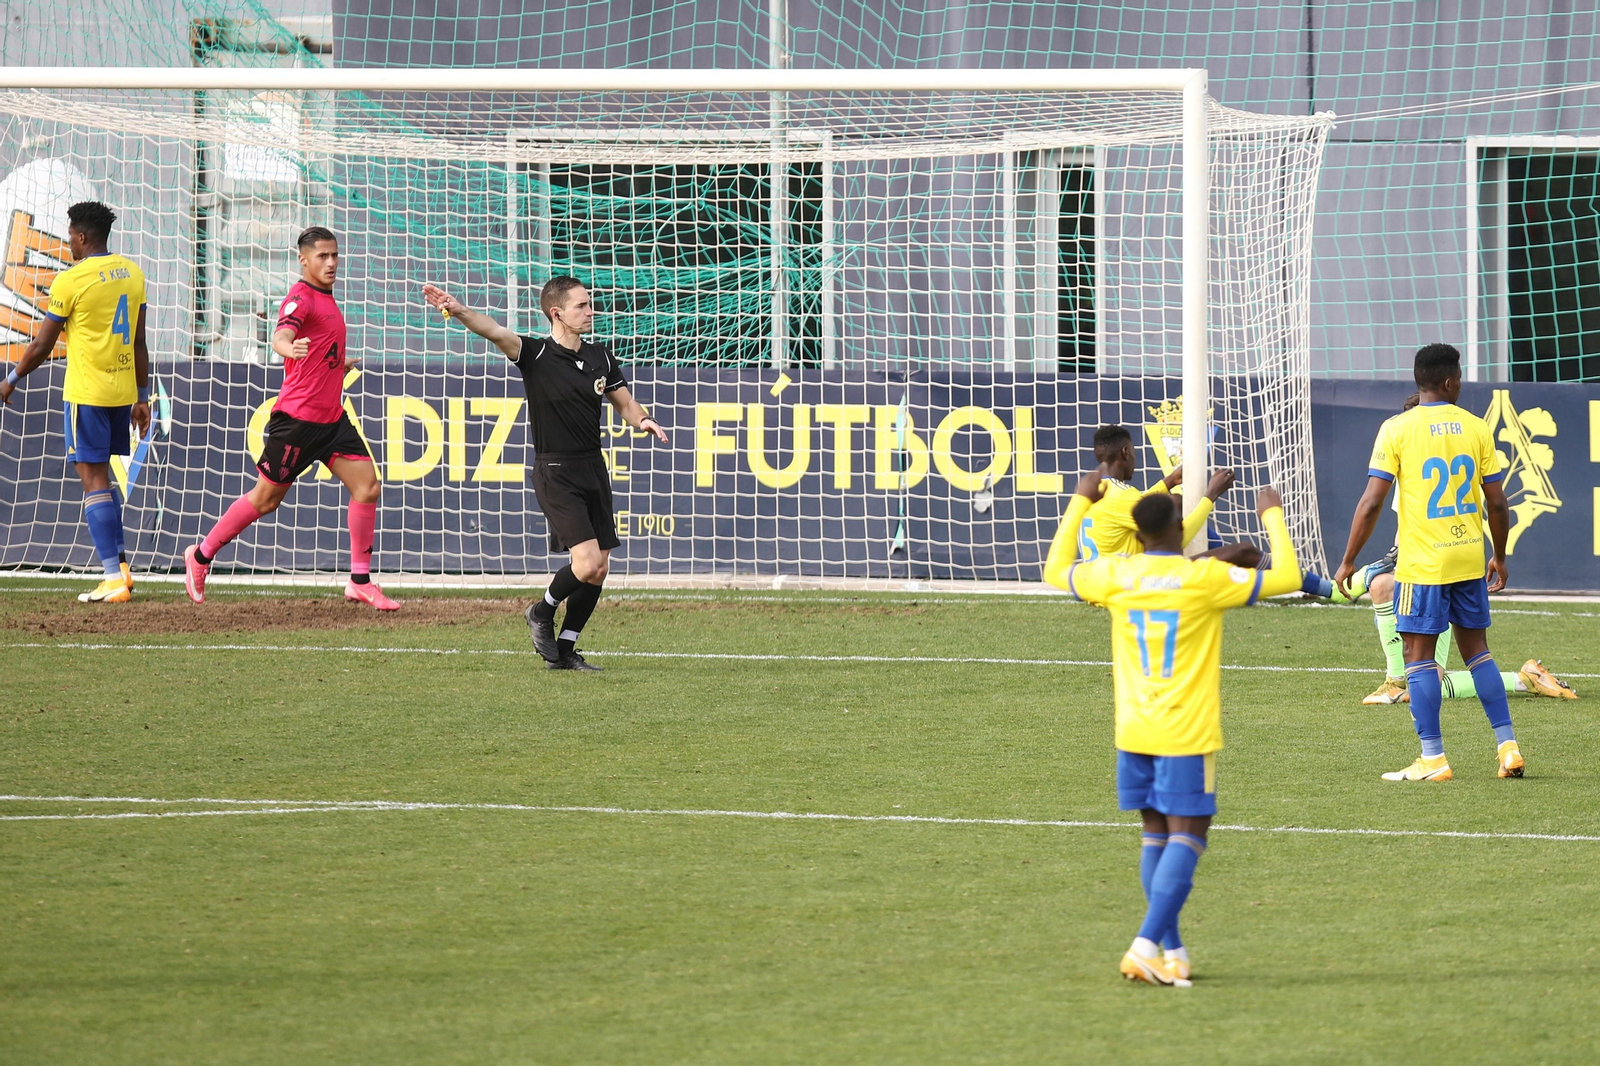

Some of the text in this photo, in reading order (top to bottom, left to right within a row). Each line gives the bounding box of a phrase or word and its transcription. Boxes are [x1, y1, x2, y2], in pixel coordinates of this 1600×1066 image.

[112, 294, 131, 346] 4
[696, 372, 1064, 492] FÚTBOL
[1429, 422, 1462, 437] PETER
[281, 443, 301, 469] 11
[1422, 454, 1478, 519] 22
[638, 514, 675, 536] 1910
[1452, 538, 1469, 546] Dental
[1128, 609, 1180, 678] 17
